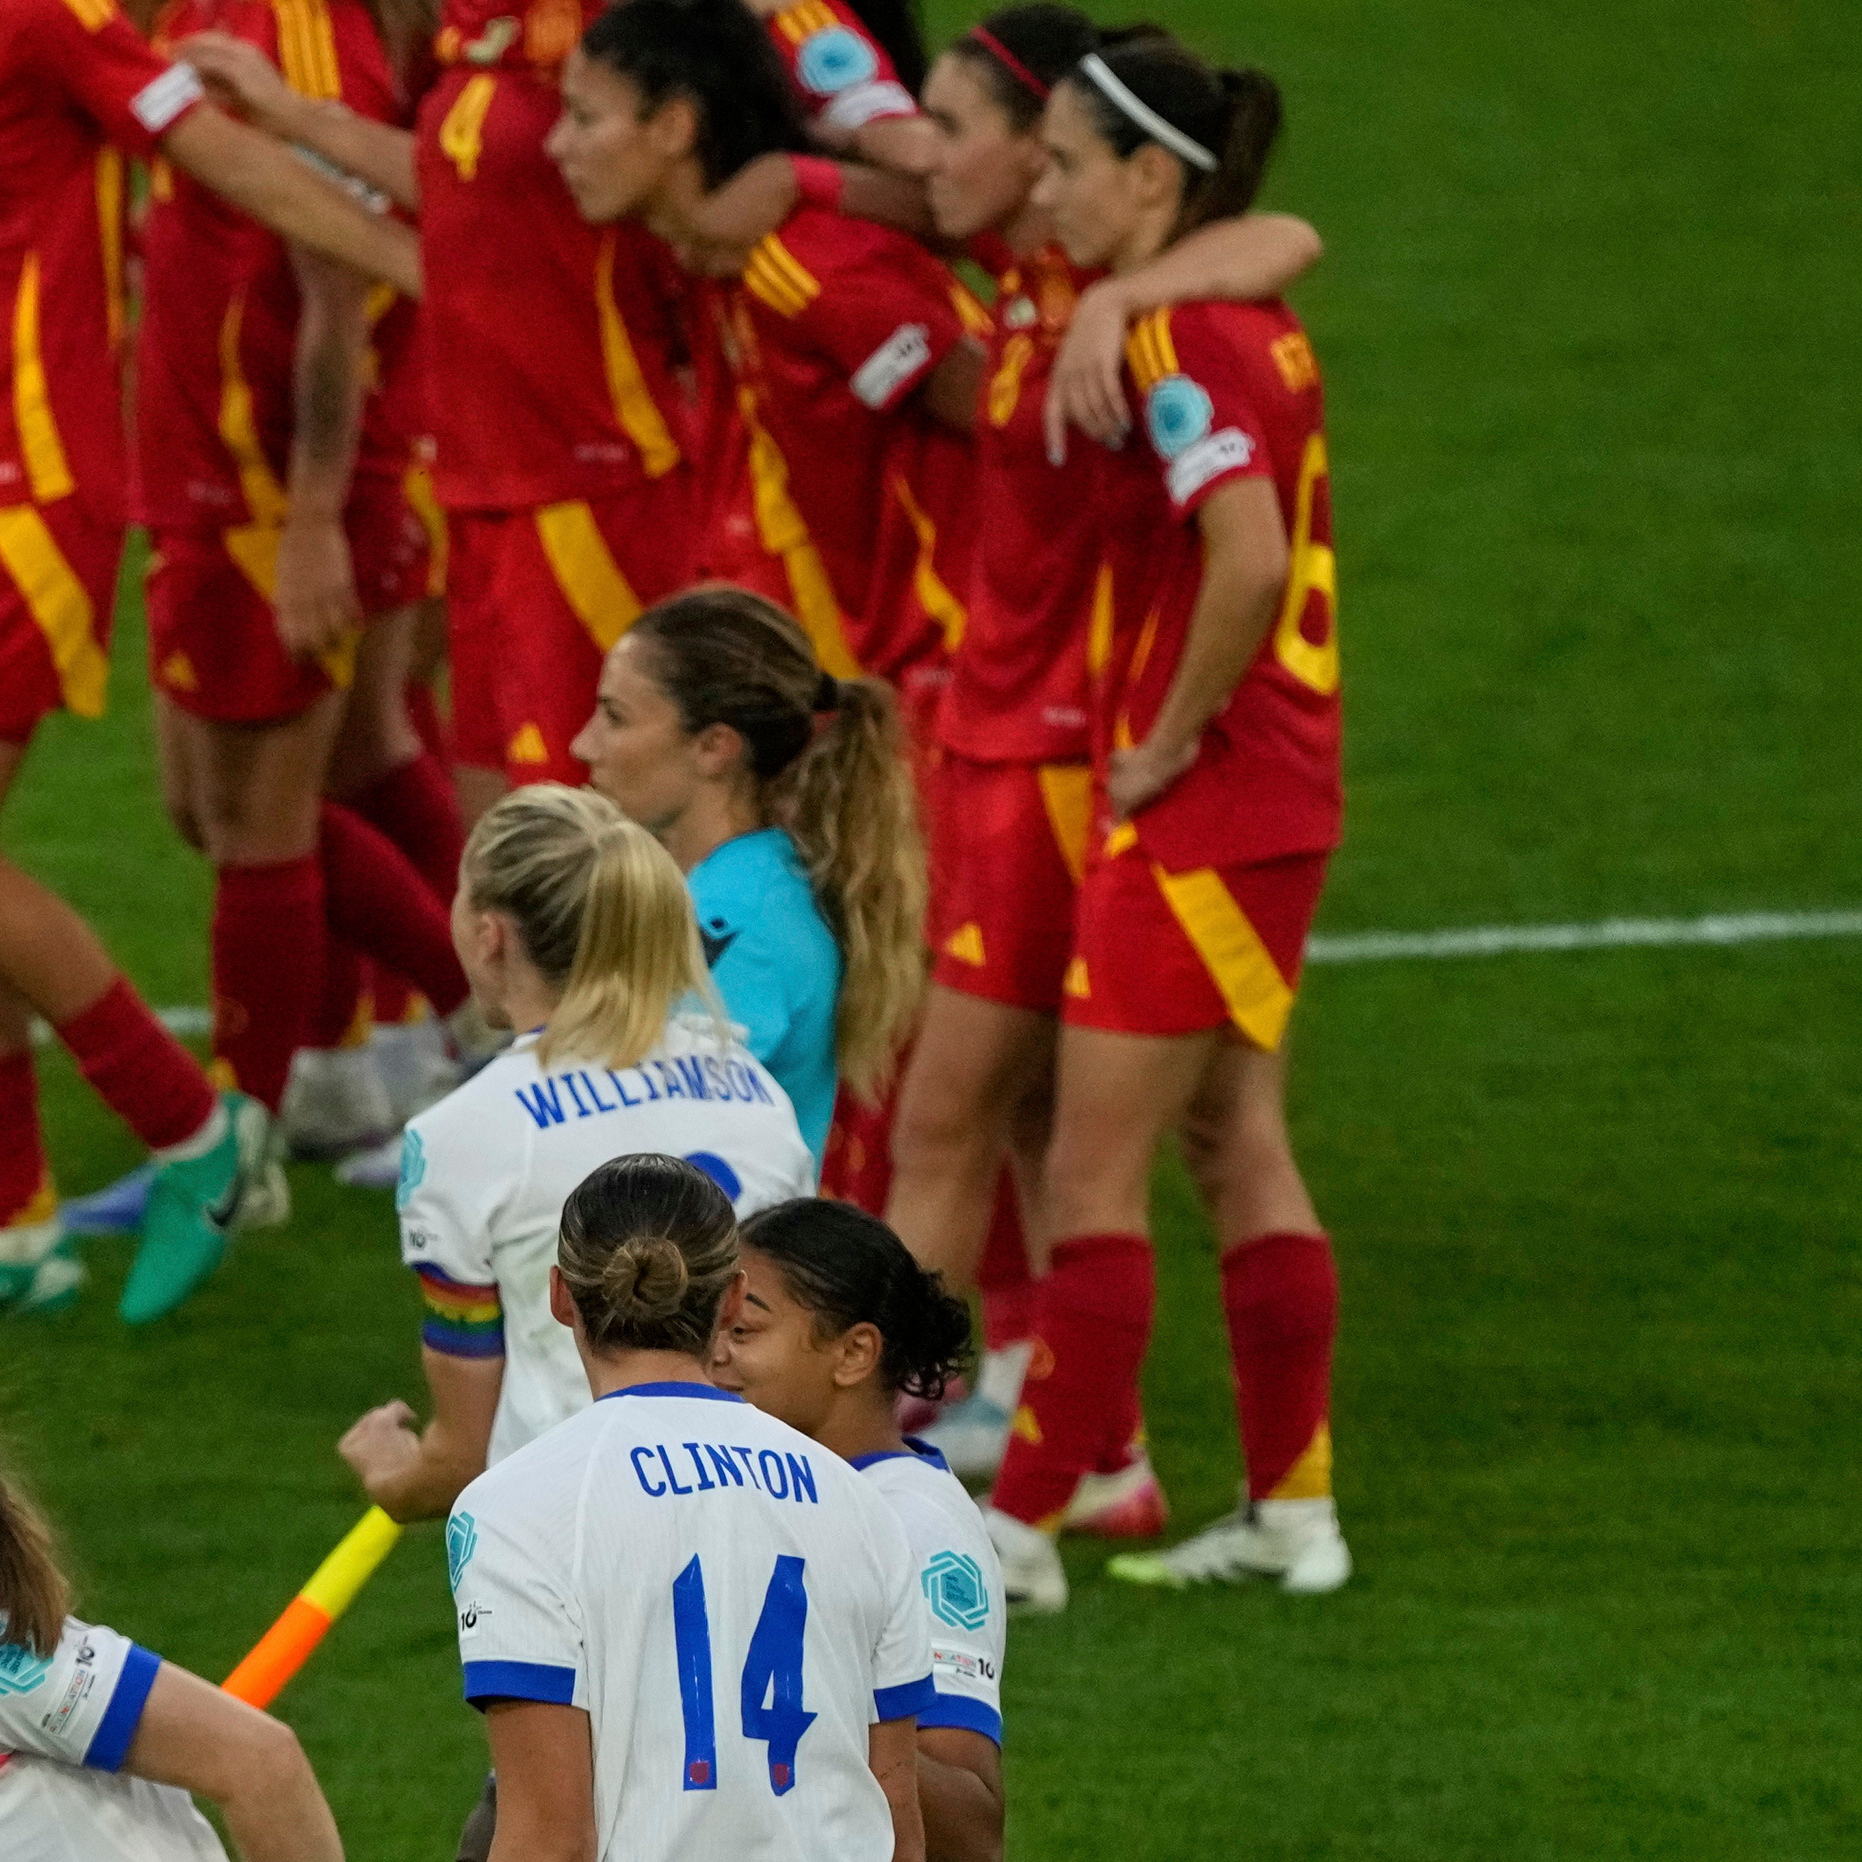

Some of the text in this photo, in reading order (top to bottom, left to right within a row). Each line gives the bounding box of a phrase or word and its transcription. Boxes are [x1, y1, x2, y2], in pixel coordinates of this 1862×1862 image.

[440, 76, 497, 181] 4
[515, 1055, 776, 1130] WILLIAMSON
[630, 1442, 818, 1504] CLINTON
[673, 1553, 818, 1797] 14
